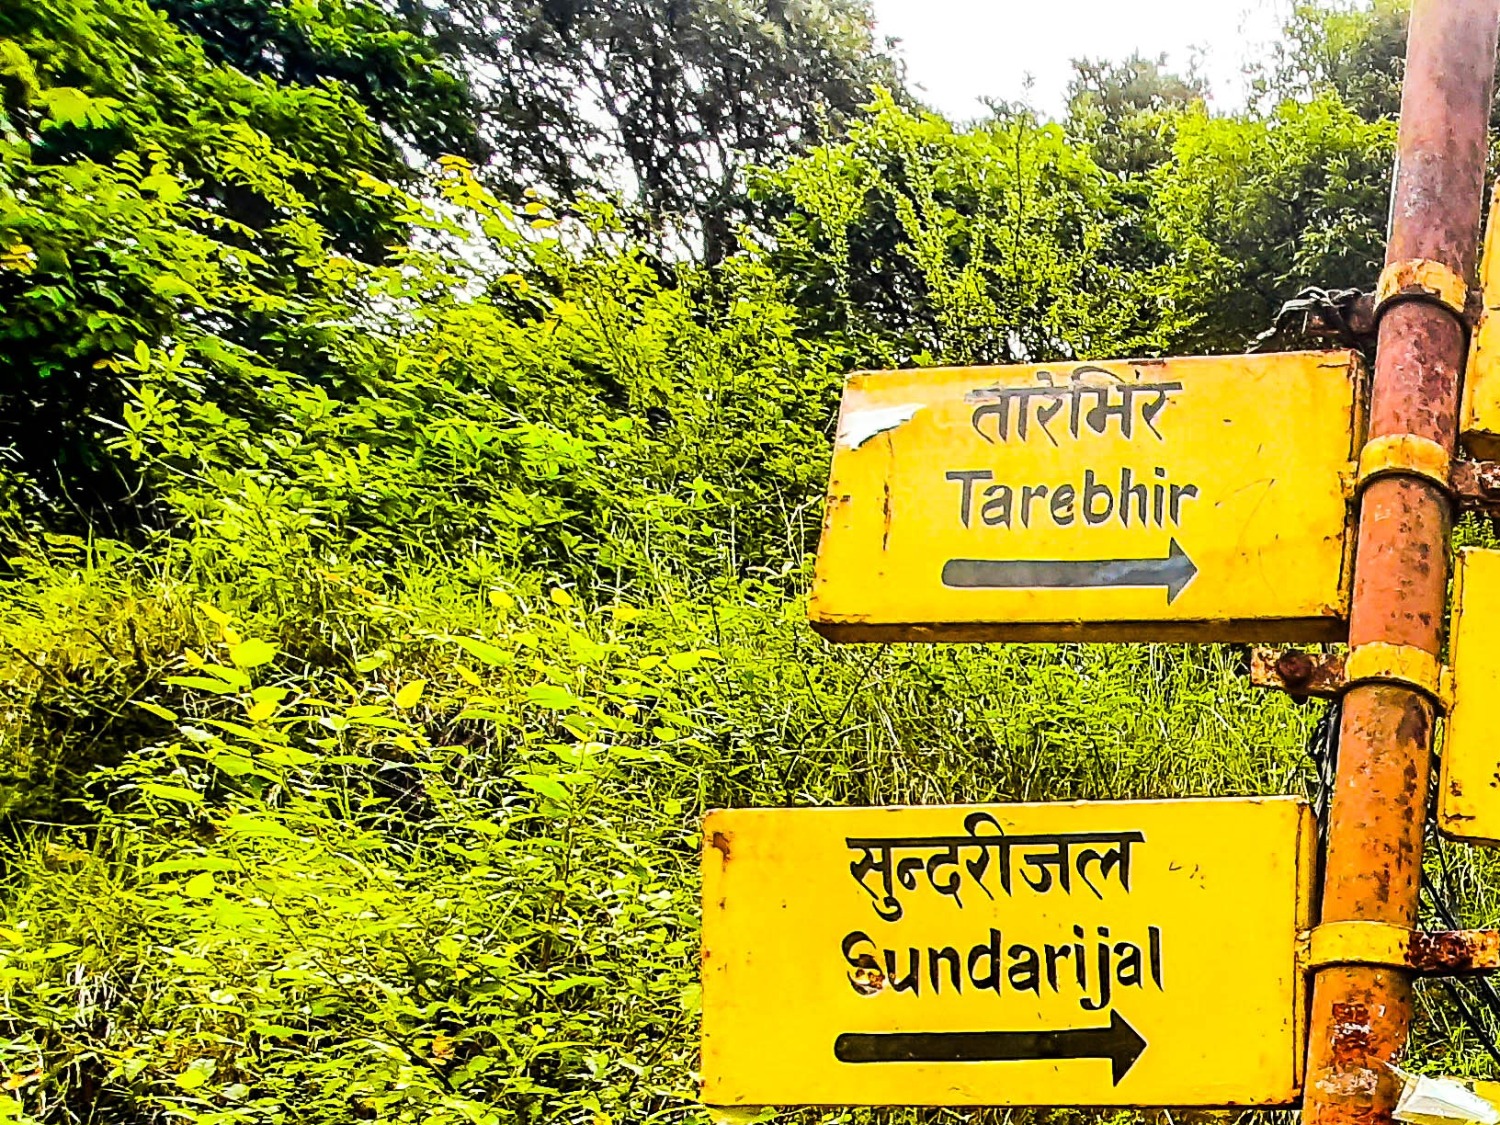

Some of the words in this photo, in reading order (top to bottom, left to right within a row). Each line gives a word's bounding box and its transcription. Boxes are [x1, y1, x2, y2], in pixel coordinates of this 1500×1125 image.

[945, 466, 1200, 531] Tarebhir
[844, 811, 1147, 923] सुन्दरीजल
[840, 925, 1164, 1011] Sundarijal
